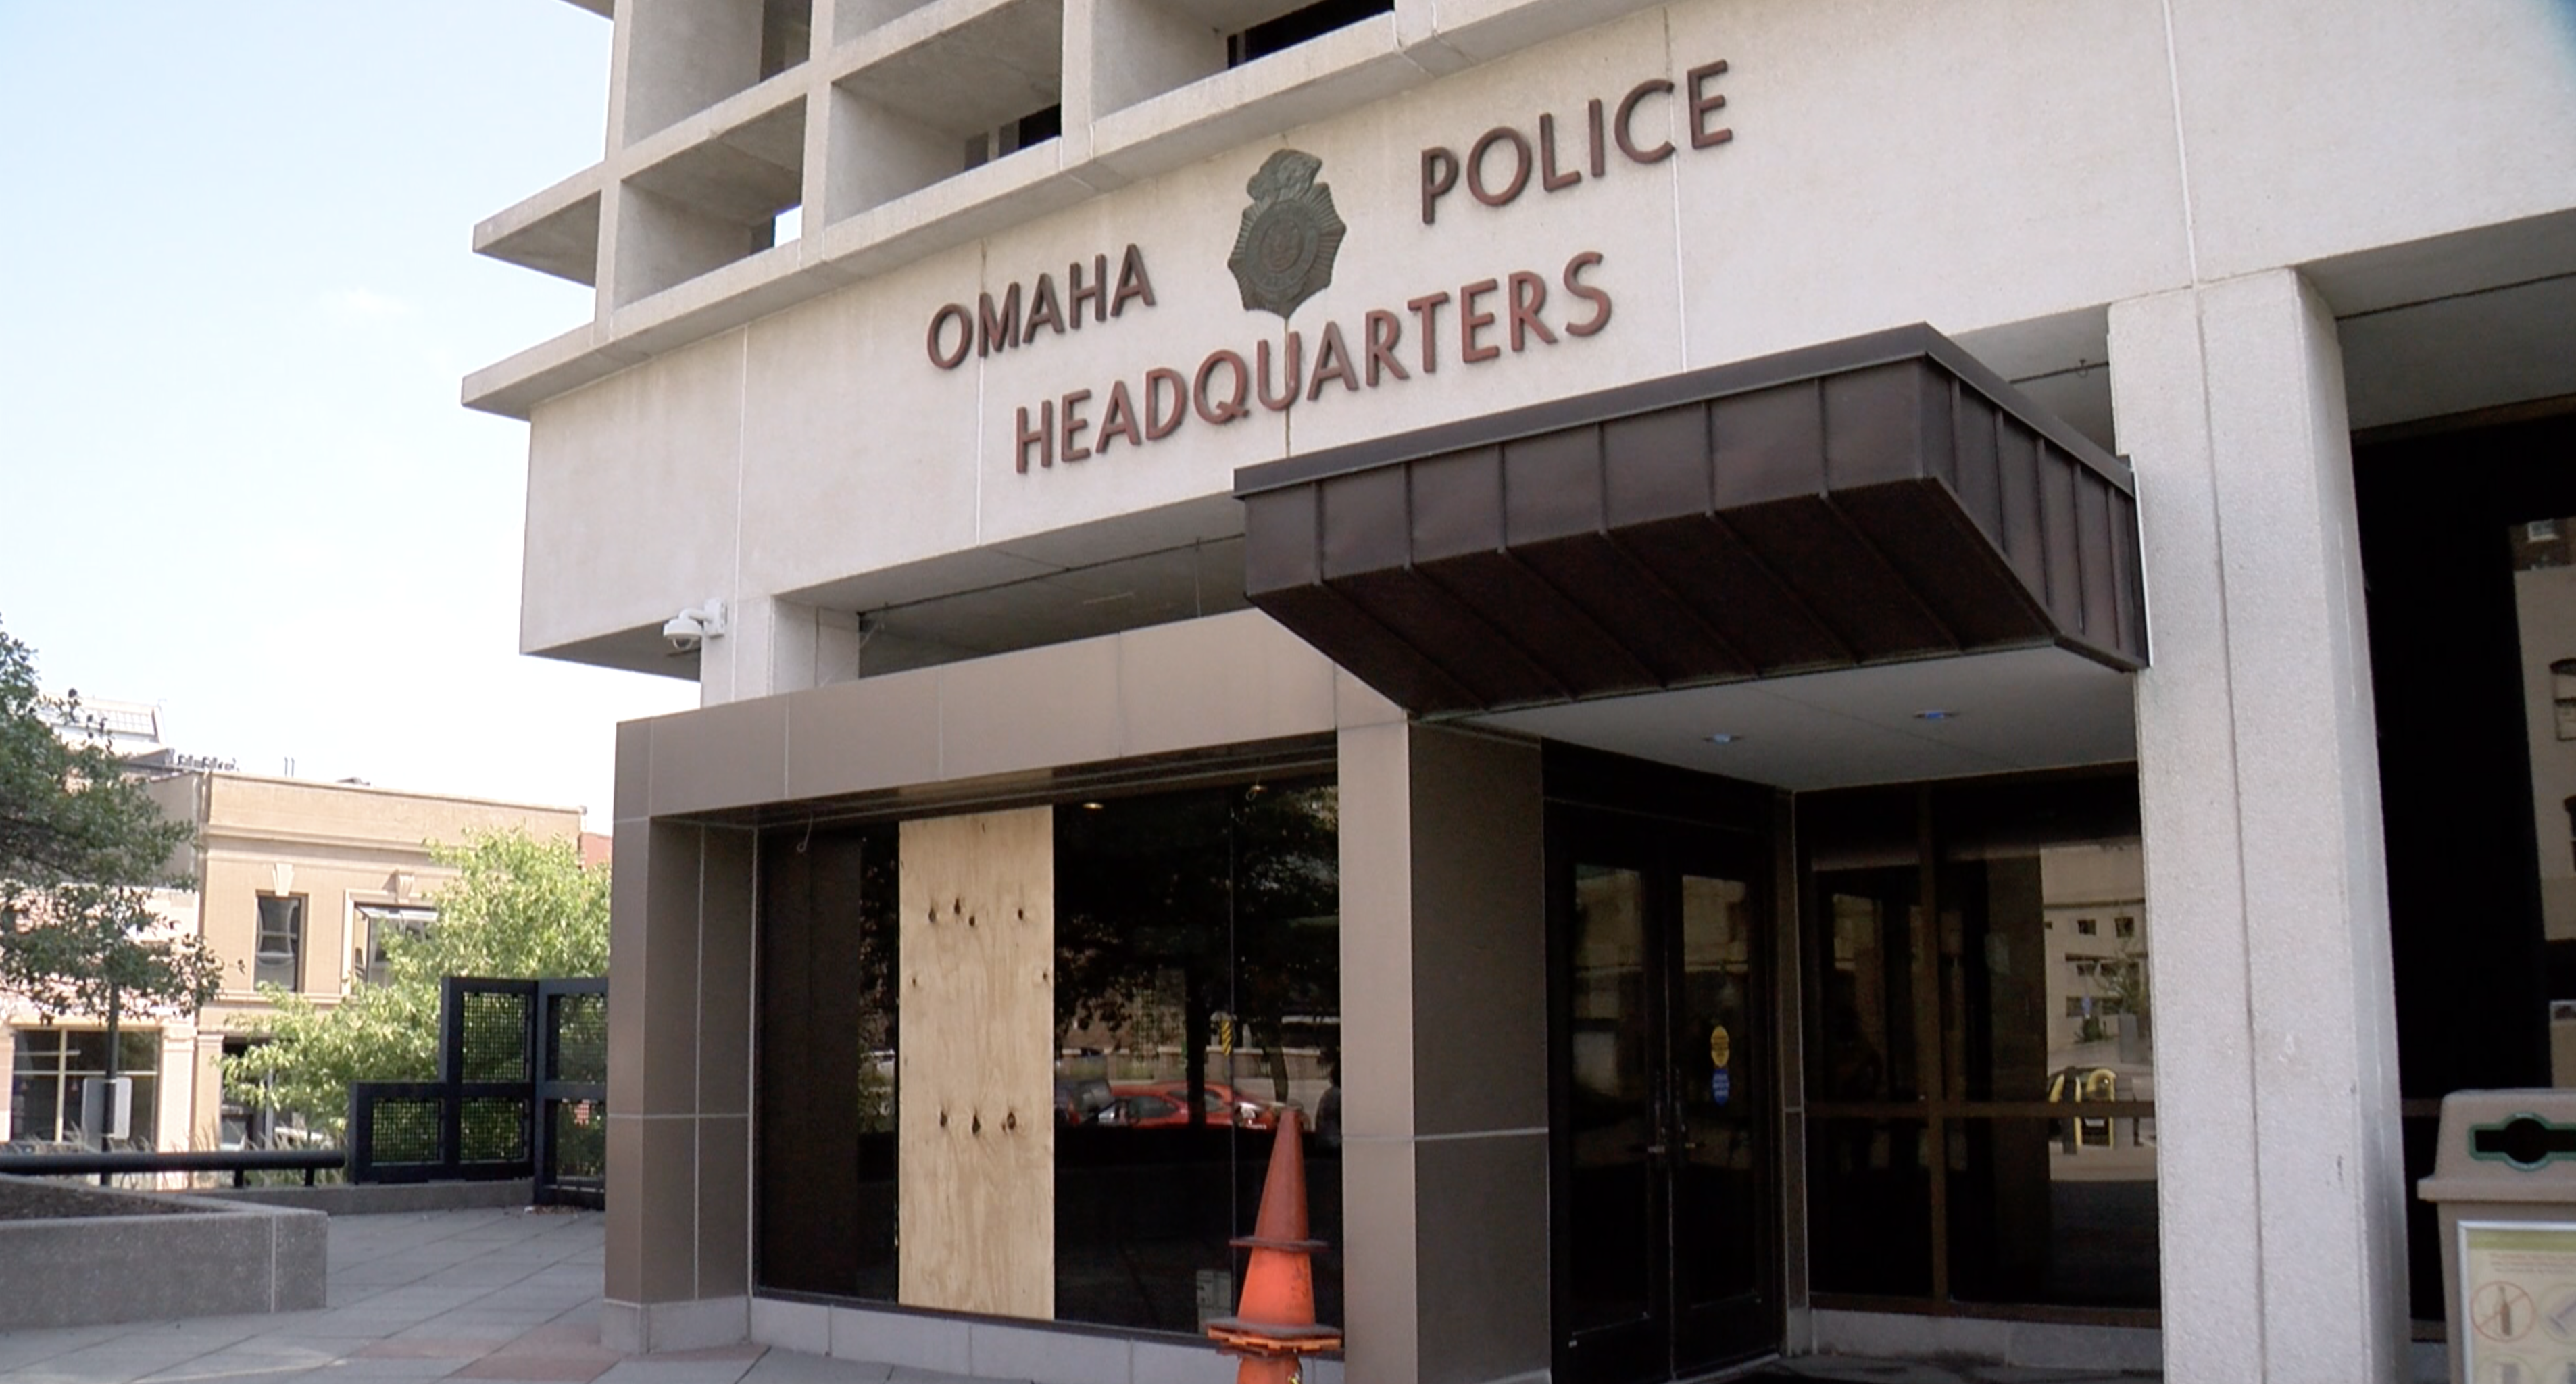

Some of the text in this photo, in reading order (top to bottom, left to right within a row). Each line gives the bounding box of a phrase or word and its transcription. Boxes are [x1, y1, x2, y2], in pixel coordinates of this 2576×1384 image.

[926, 59, 1735, 372] OMAHA POLICE
[1015, 251, 1614, 476] HEADQUARTERS
